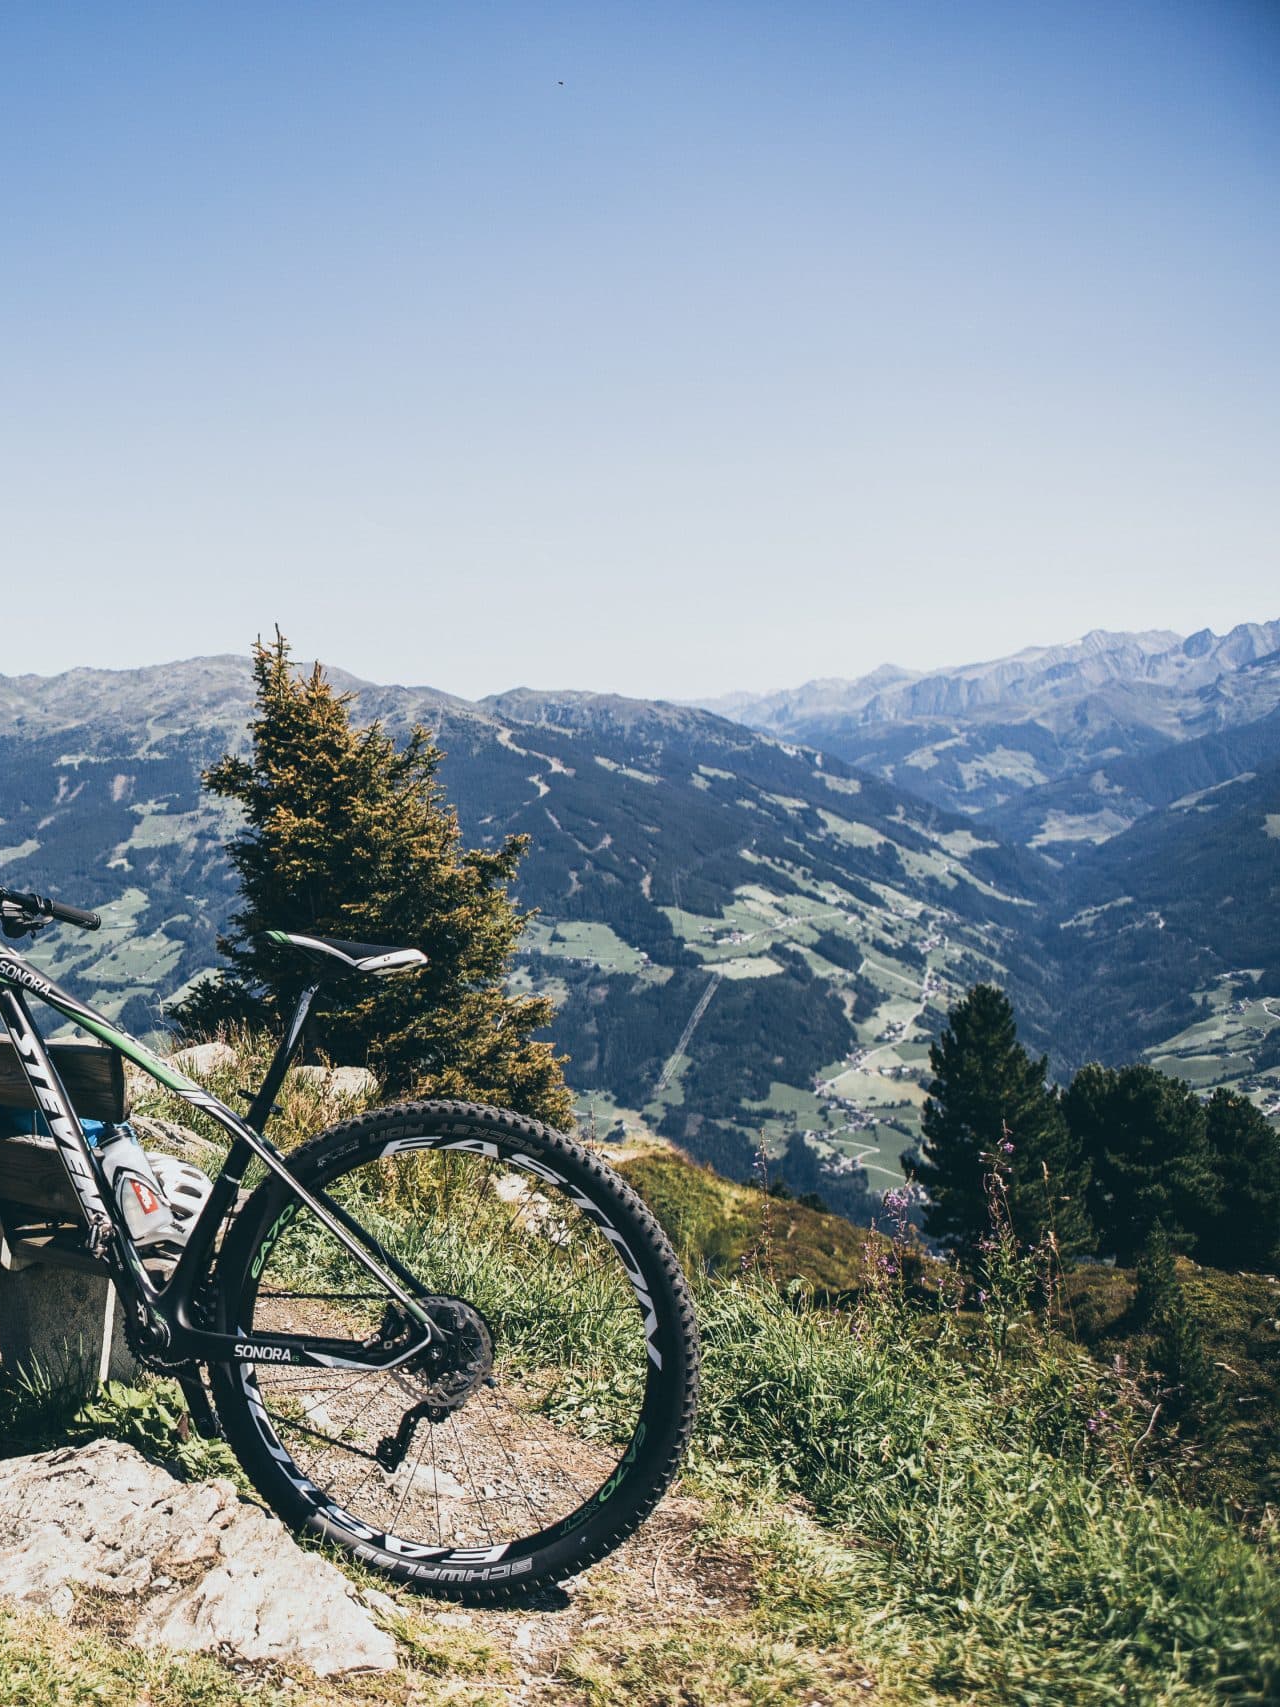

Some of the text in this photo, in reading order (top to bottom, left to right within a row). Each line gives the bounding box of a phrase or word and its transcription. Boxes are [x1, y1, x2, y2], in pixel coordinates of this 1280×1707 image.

[8, 1027, 111, 1218] STEVEN
[251, 1204, 295, 1279] EA70
[378, 1136, 663, 1372] EASTON
[234, 1344, 291, 1362] SONORA
[598, 1420, 647, 1502] EA70
[352, 1544, 533, 1583] SCHWALBE
